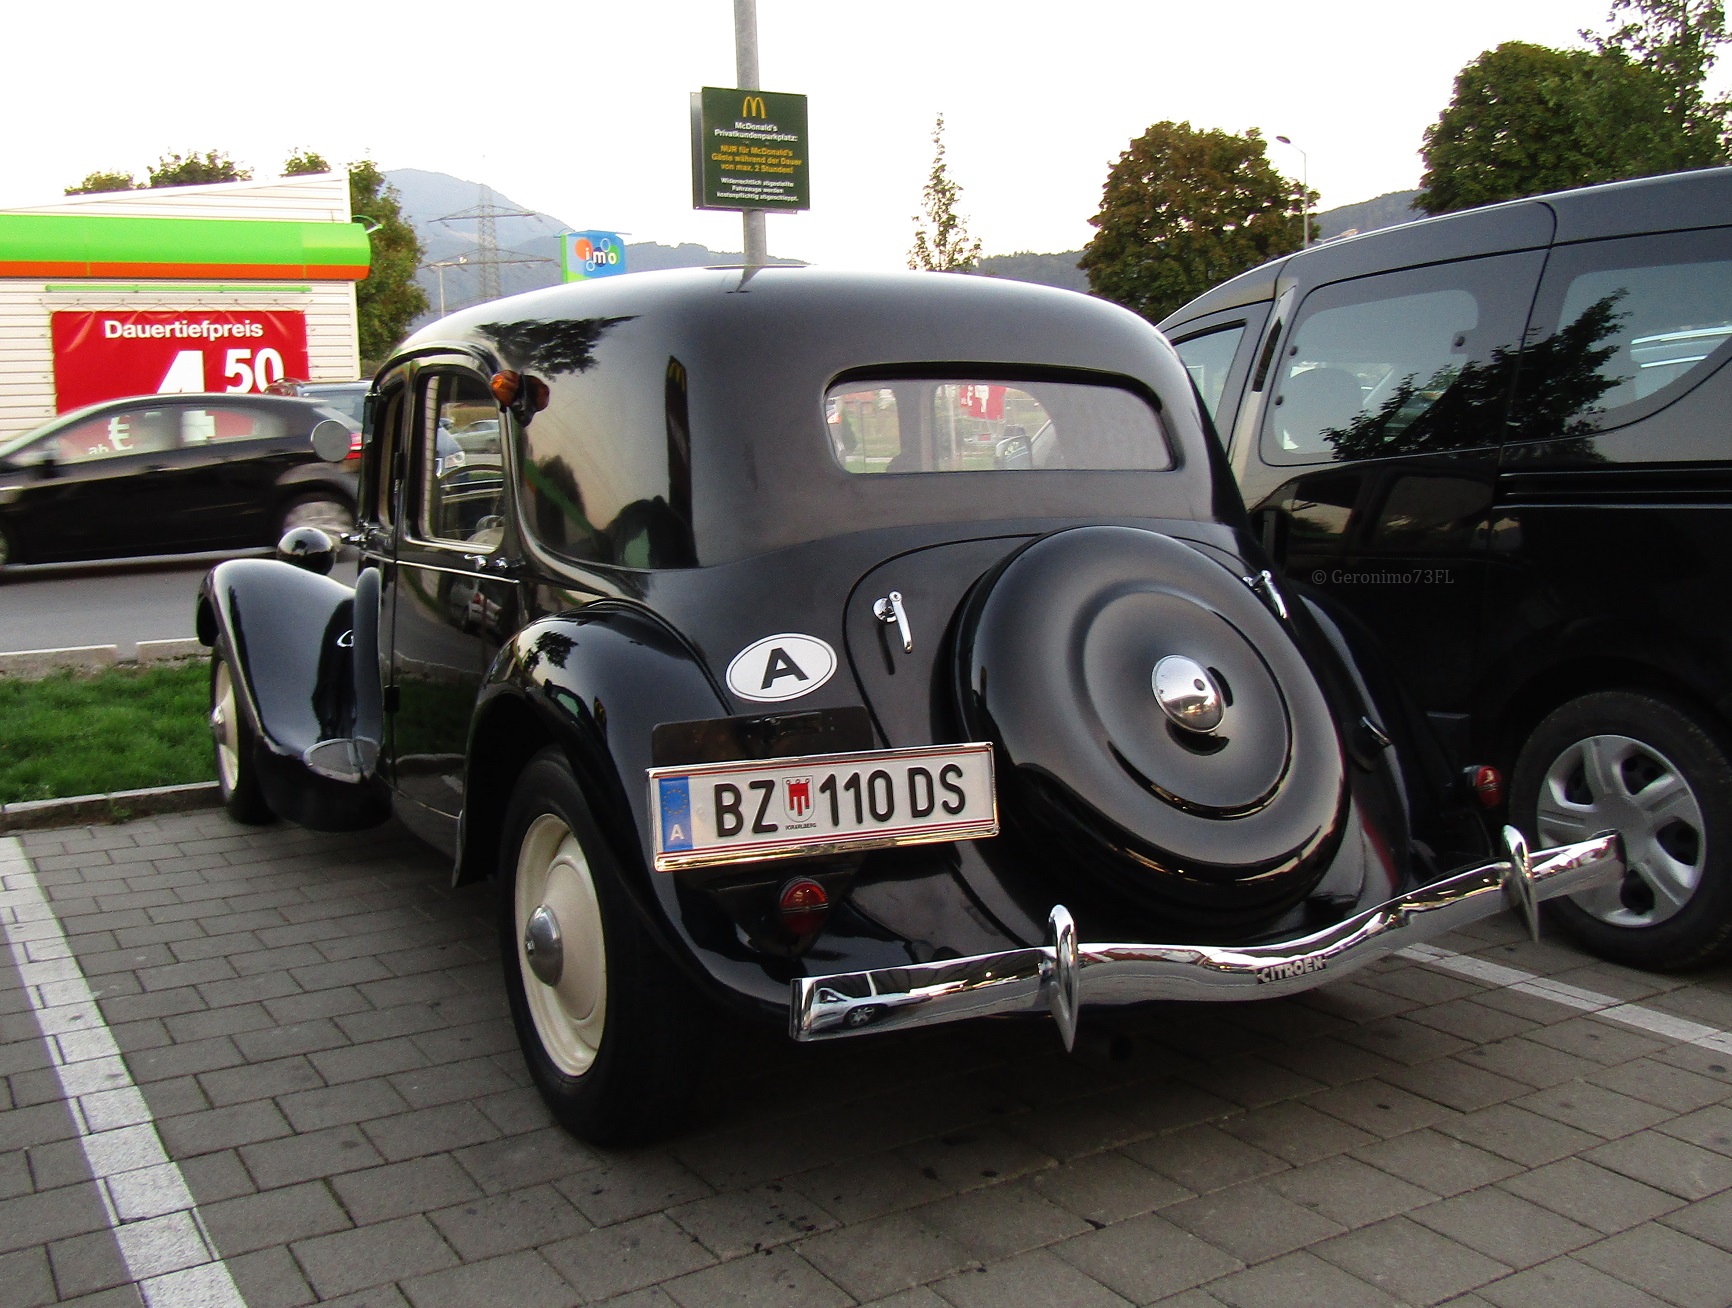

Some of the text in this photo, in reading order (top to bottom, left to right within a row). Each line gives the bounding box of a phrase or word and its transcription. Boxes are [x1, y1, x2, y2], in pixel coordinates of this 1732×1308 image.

[714, 128, 798, 142] Privatkundenparkplatz:
[734, 121, 778, 132] McDonald's
[720, 145, 738, 153] NUR
[751, 147, 793, 157] McDonald's
[767, 156, 779, 164] der
[780, 158, 802, 166] Dauer
[585, 247, 617, 265] imo
[103, 319, 264, 341] Dauertiefpreis
[760, 647, 809, 690] A
[713, 763, 966, 837] BZ 110 DS
[670, 823, 686, 842] A
